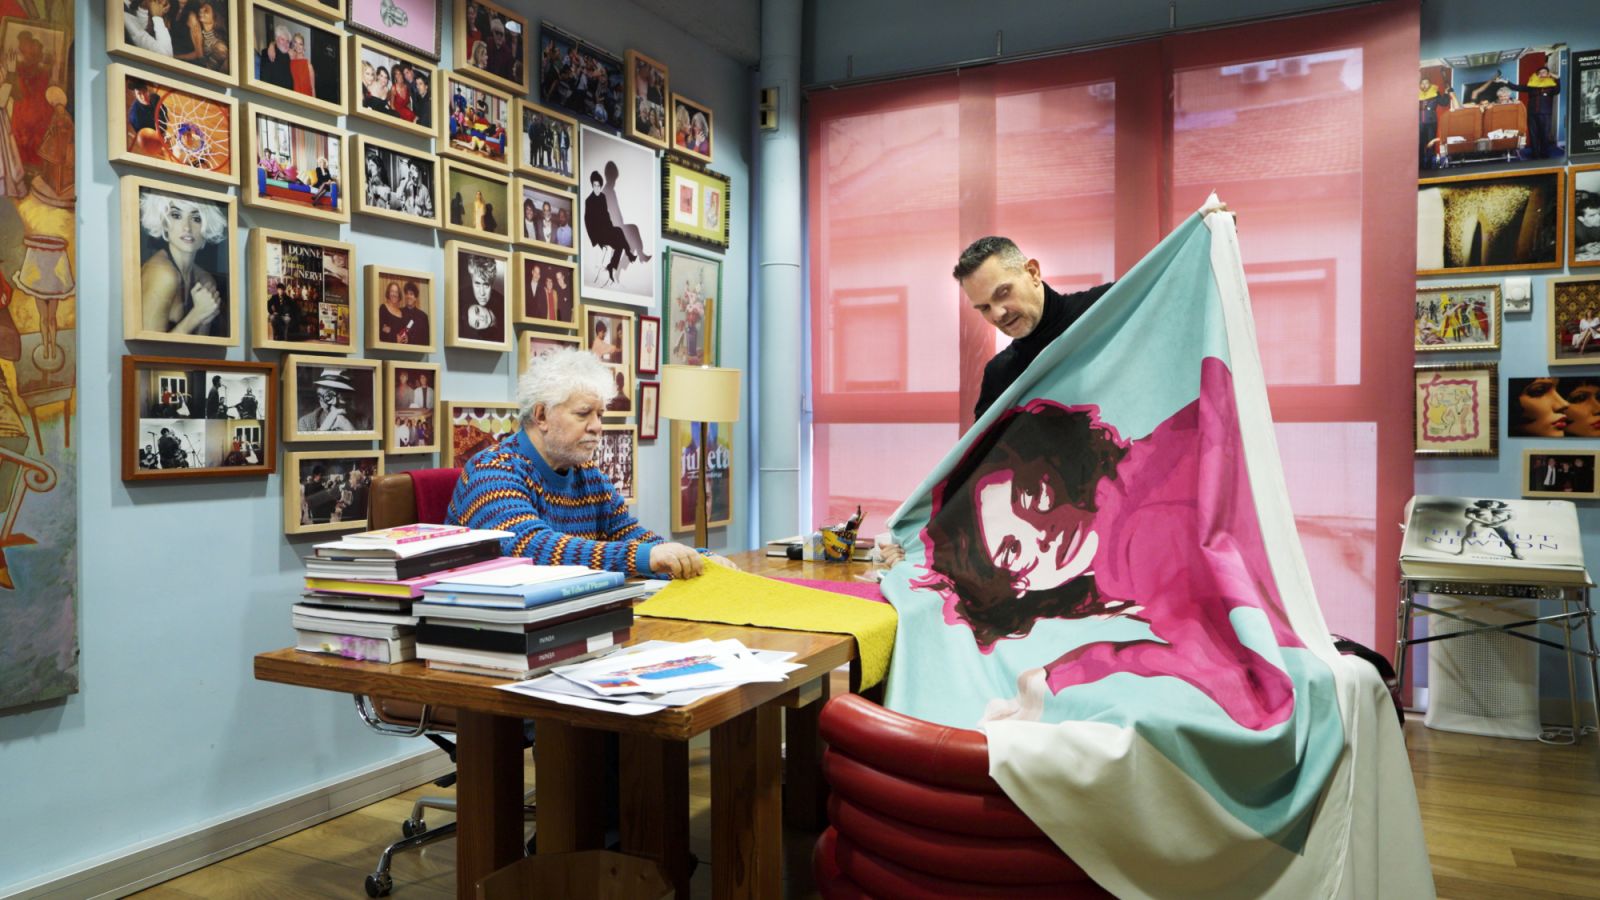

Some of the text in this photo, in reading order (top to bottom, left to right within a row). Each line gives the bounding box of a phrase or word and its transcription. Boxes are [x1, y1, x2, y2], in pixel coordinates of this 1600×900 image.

[288, 244, 323, 259] DONNE
[298, 269, 322, 281] NERVI
[680, 445, 729, 478] juleta
[1424, 536, 1558, 550] NEWTON
